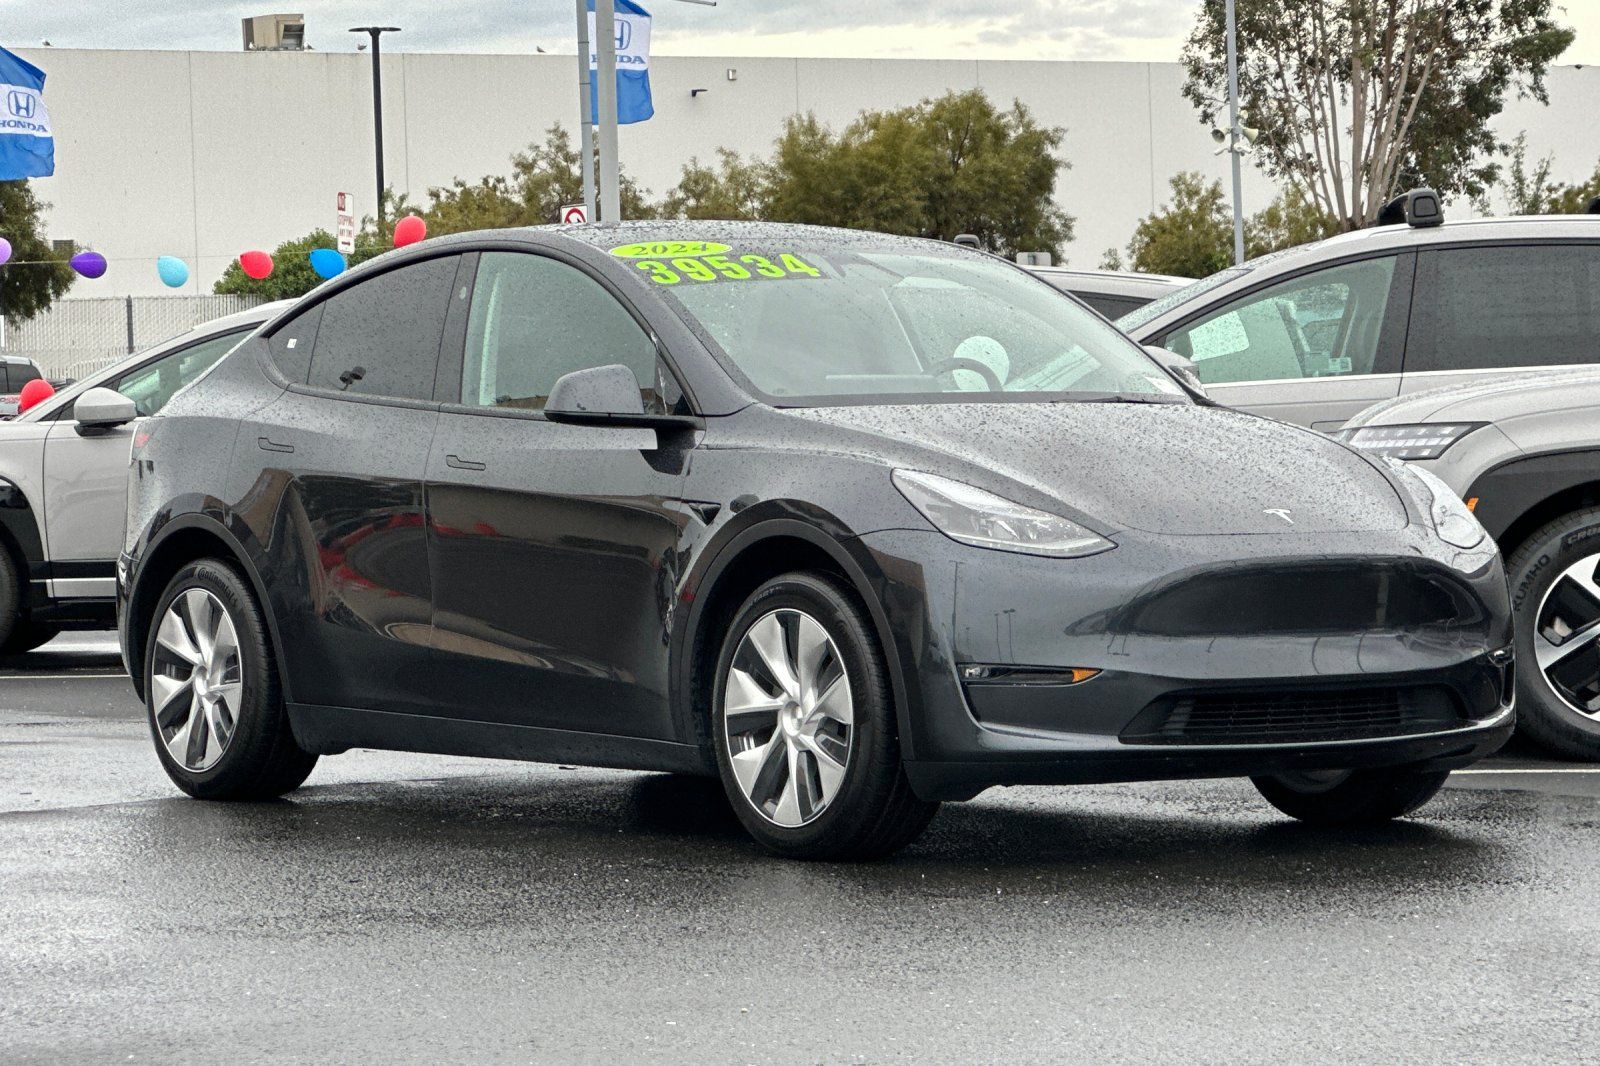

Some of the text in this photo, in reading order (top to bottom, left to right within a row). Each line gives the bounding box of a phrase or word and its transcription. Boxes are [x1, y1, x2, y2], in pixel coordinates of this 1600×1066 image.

[591, 54, 646, 65] HDA
[0, 119, 48, 133] HONDA
[632, 243, 704, 256] 2024
[635, 253, 821, 285] 39534
[1567, 525, 1600, 545] CRU
[198, 566, 235, 601] Continental
[1513, 553, 1552, 612] KUMHO
